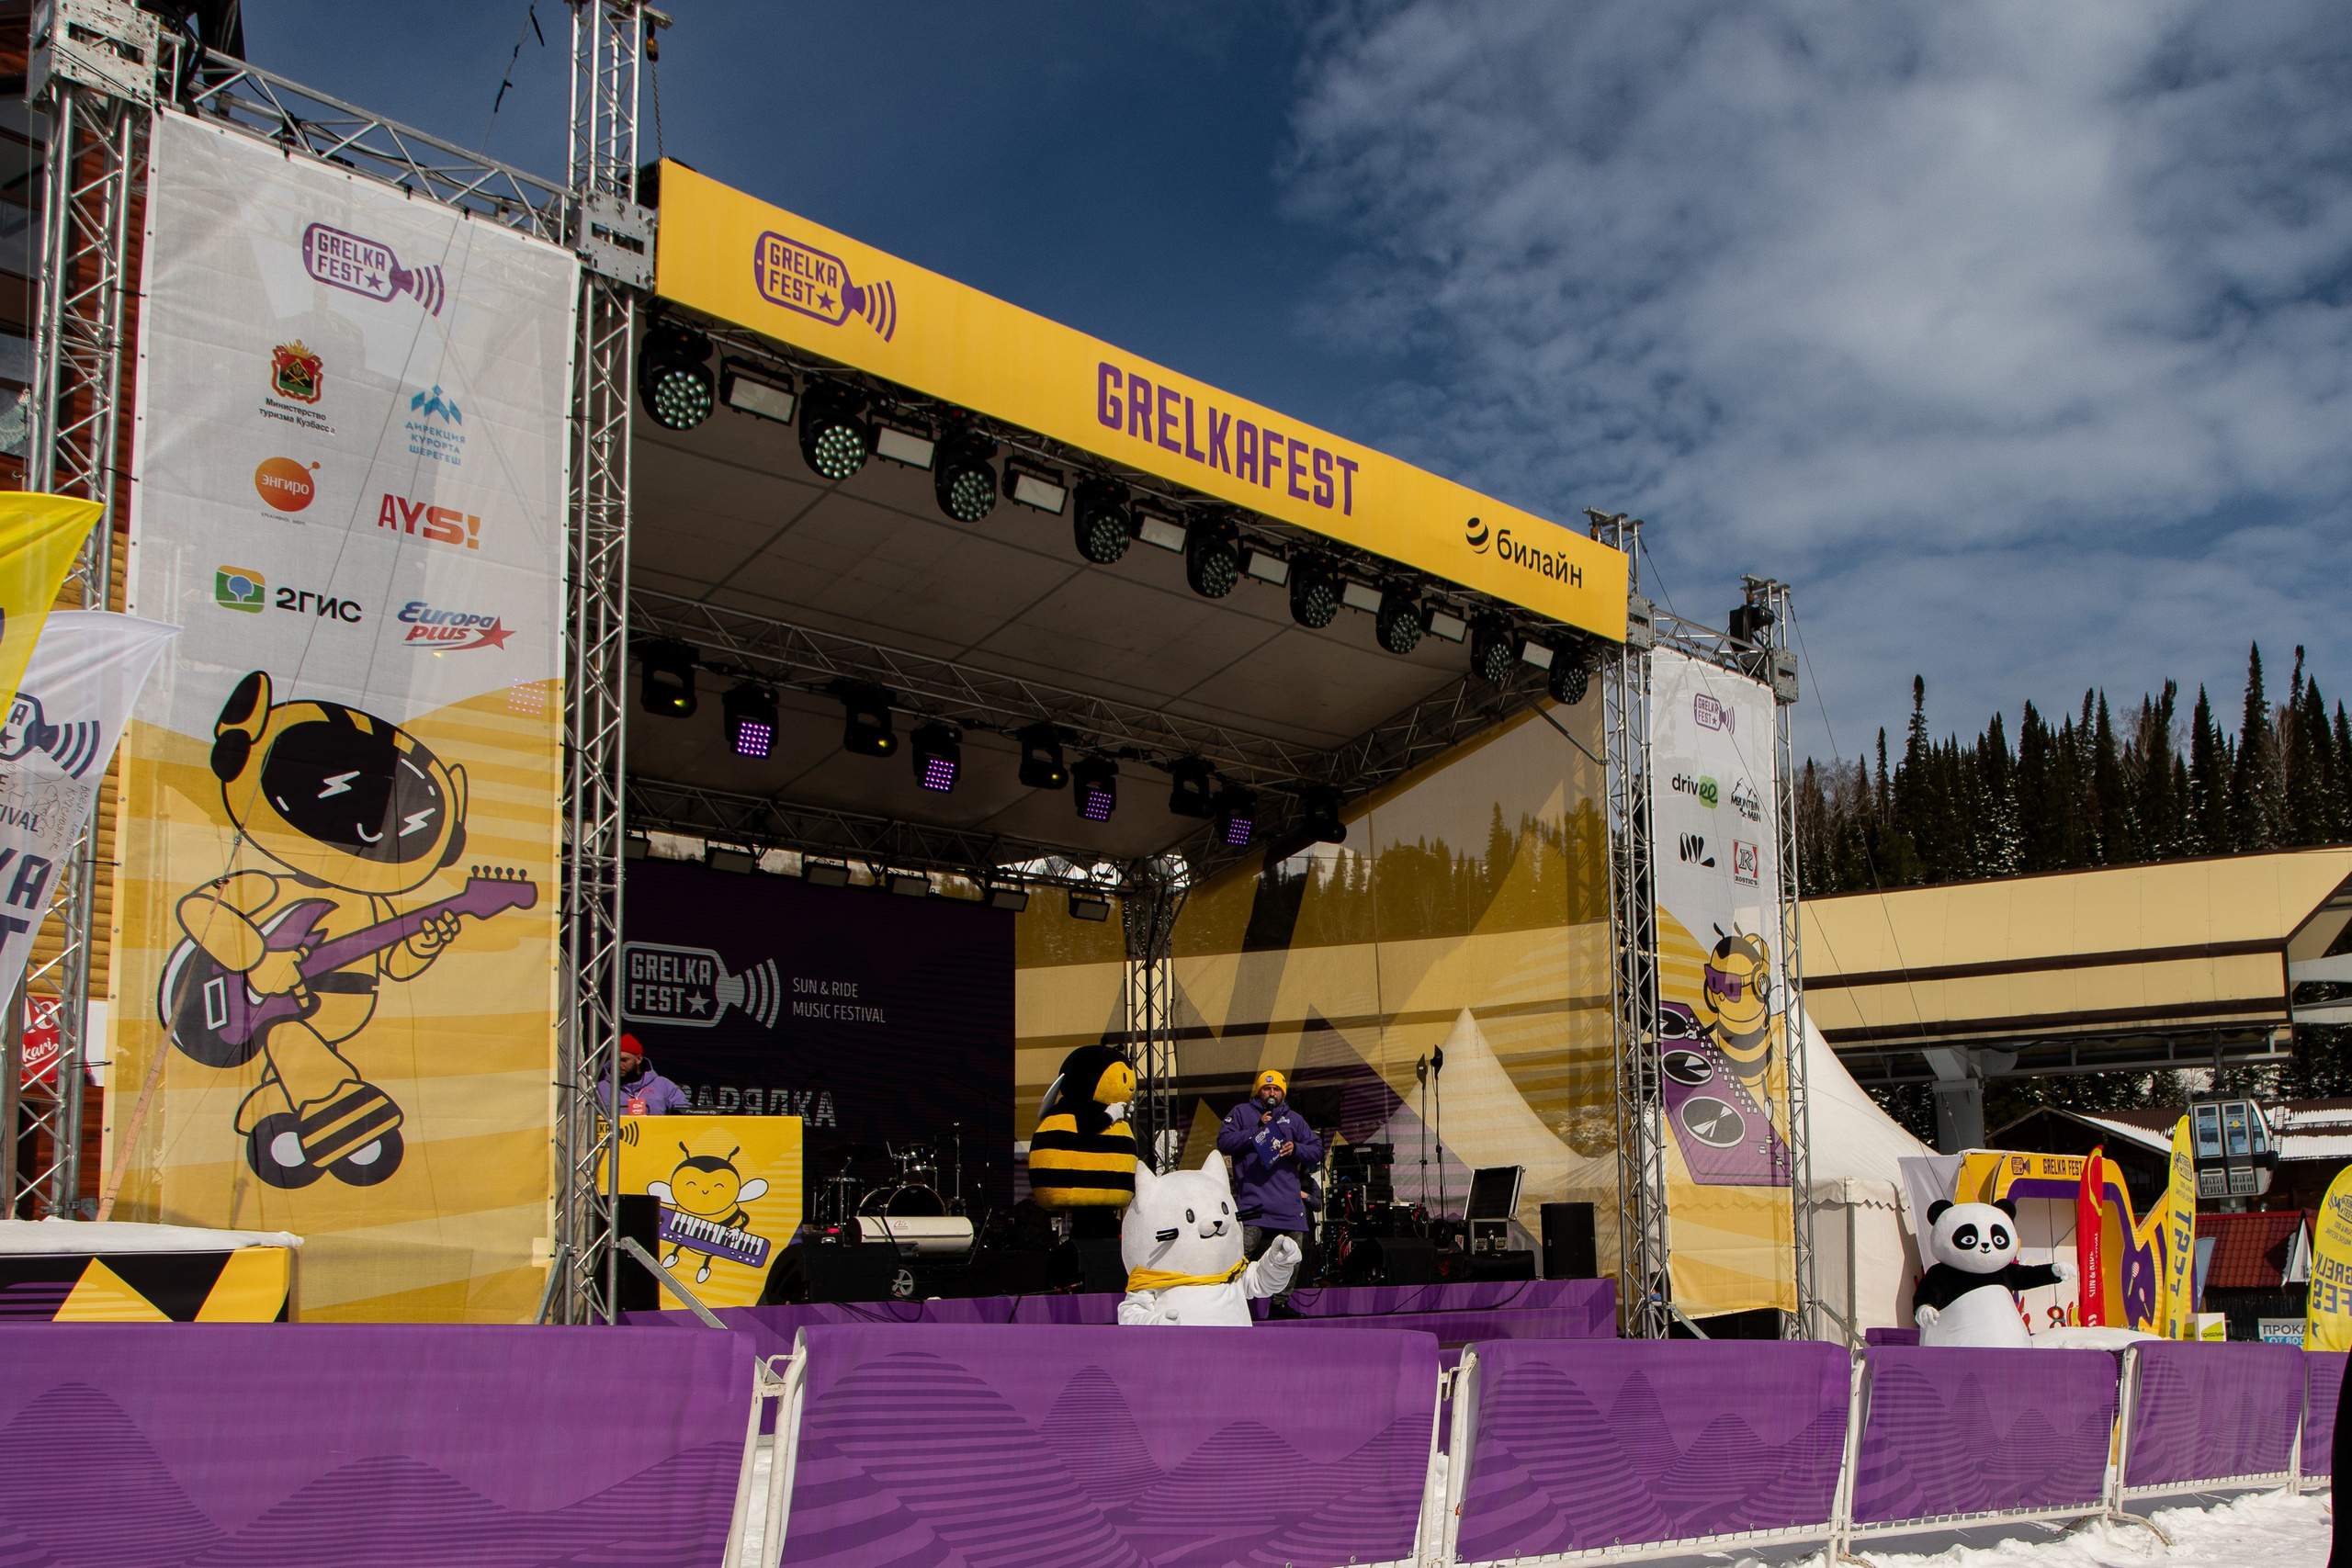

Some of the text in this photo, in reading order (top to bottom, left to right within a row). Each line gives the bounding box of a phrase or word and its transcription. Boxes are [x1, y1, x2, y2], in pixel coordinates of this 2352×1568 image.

[318, 232, 386, 271] GRELKA
[317, 254, 364, 286] FEST
[769, 242, 838, 289] GRELKA
[769, 268, 816, 307] FEST
[258, 407, 335, 434] туризма Кузбасса
[265, 397, 327, 422] Министерство
[405, 421, 466, 445] ДИРЕКЦИЯ
[411, 433, 461, 455] КУРОРТА
[1097, 361, 1359, 517] GRELKAFEST
[409, 444, 461, 467] ШЕРЕГЕШ
[262, 473, 310, 496] энгиро
[378, 492, 481, 550] AYS!
[1497, 528, 1584, 590] билайн
[276, 586, 363, 624] 2ГИС
[397, 601, 496, 628] Europa
[1698, 710, 1712, 725] FEST
[1671, 773, 1718, 804] drivee
[630, 953, 712, 987] GRELKA
[630, 983, 685, 1013] FEST
[792, 976, 859, 998] SUN & RIDE
[792, 1000, 886, 1023] MUSIC FESTIVAL
[2042, 1158, 2066, 1176] GRELKA
[2068, 1159, 2083, 1177] FEST
[2263, 1325, 2306, 1335] ПРОК
